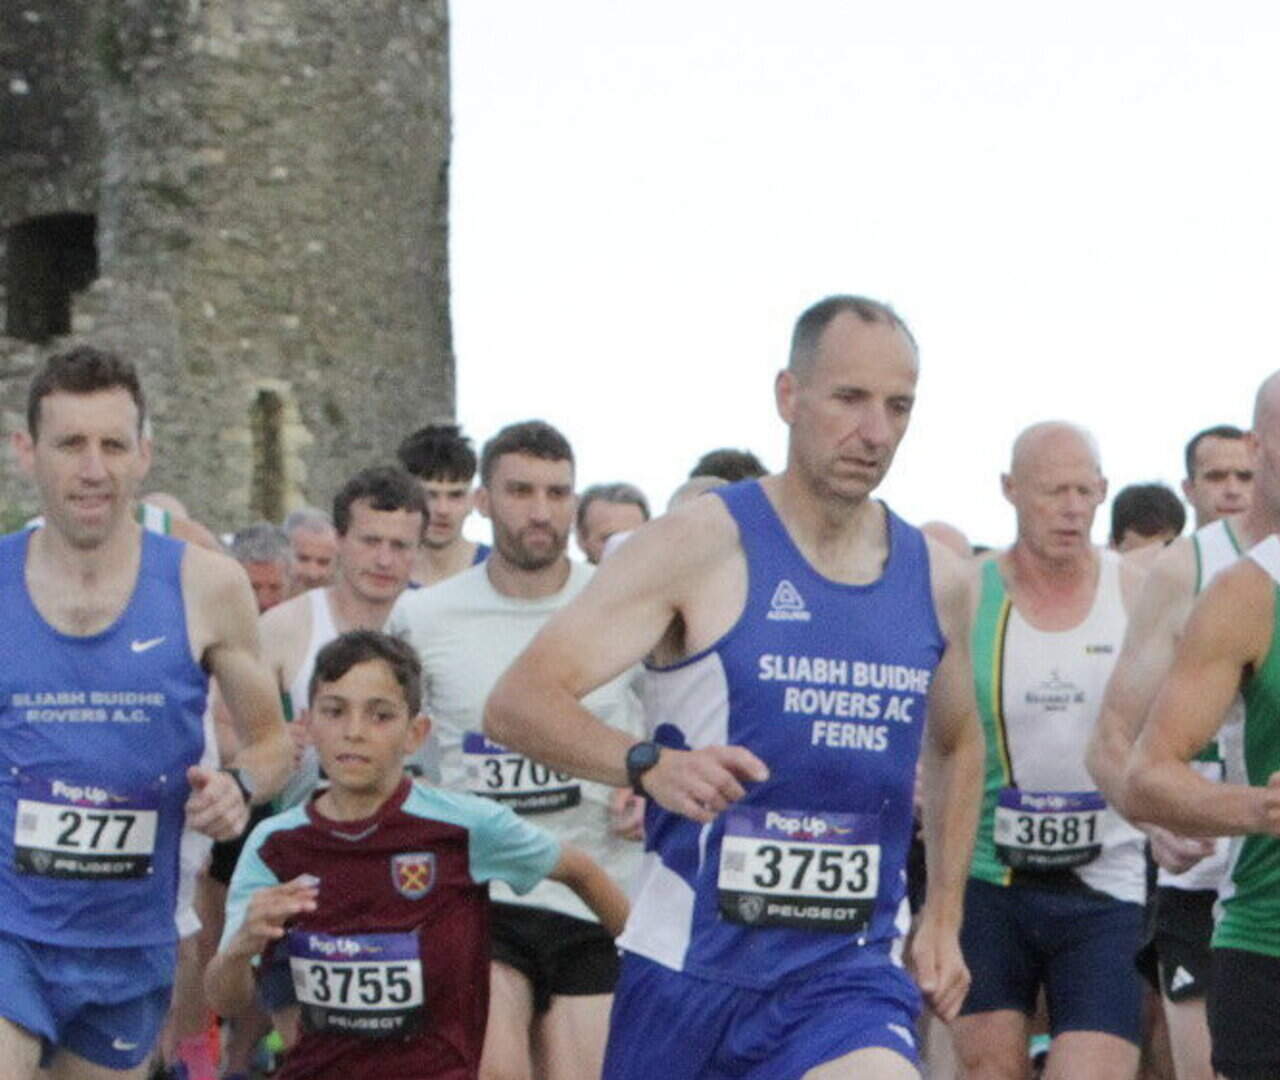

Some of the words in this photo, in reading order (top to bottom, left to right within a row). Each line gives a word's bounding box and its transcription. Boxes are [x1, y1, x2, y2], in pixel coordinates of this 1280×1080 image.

[757, 653, 848, 686] SLIABH
[852, 660, 932, 695] BUIDHE
[12, 692, 86, 708] SLIABH
[783, 686, 881, 720] ROVERS
[883, 696, 915, 723] AC
[26, 708, 108, 723] ROVERS
[111, 708, 151, 723] A.C.
[811, 720, 890, 752] FERNS
[52, 780, 83, 801] Pop
[84, 785, 109, 805] Up
[56, 811, 137, 850] 277
[765, 811, 800, 836] Pop
[801, 815, 828, 839] Up
[1015, 814, 1097, 846] 3681
[53, 858, 136, 874] PEUGEOT
[753, 845, 870, 894] 3753
[766, 903, 858, 921] PEUGEOT
[308, 934, 336, 956] Pop
[336, 937, 361, 957] Up
[309, 964, 413, 1005] 3755
[327, 1014, 403, 1030] PEUGEOT
